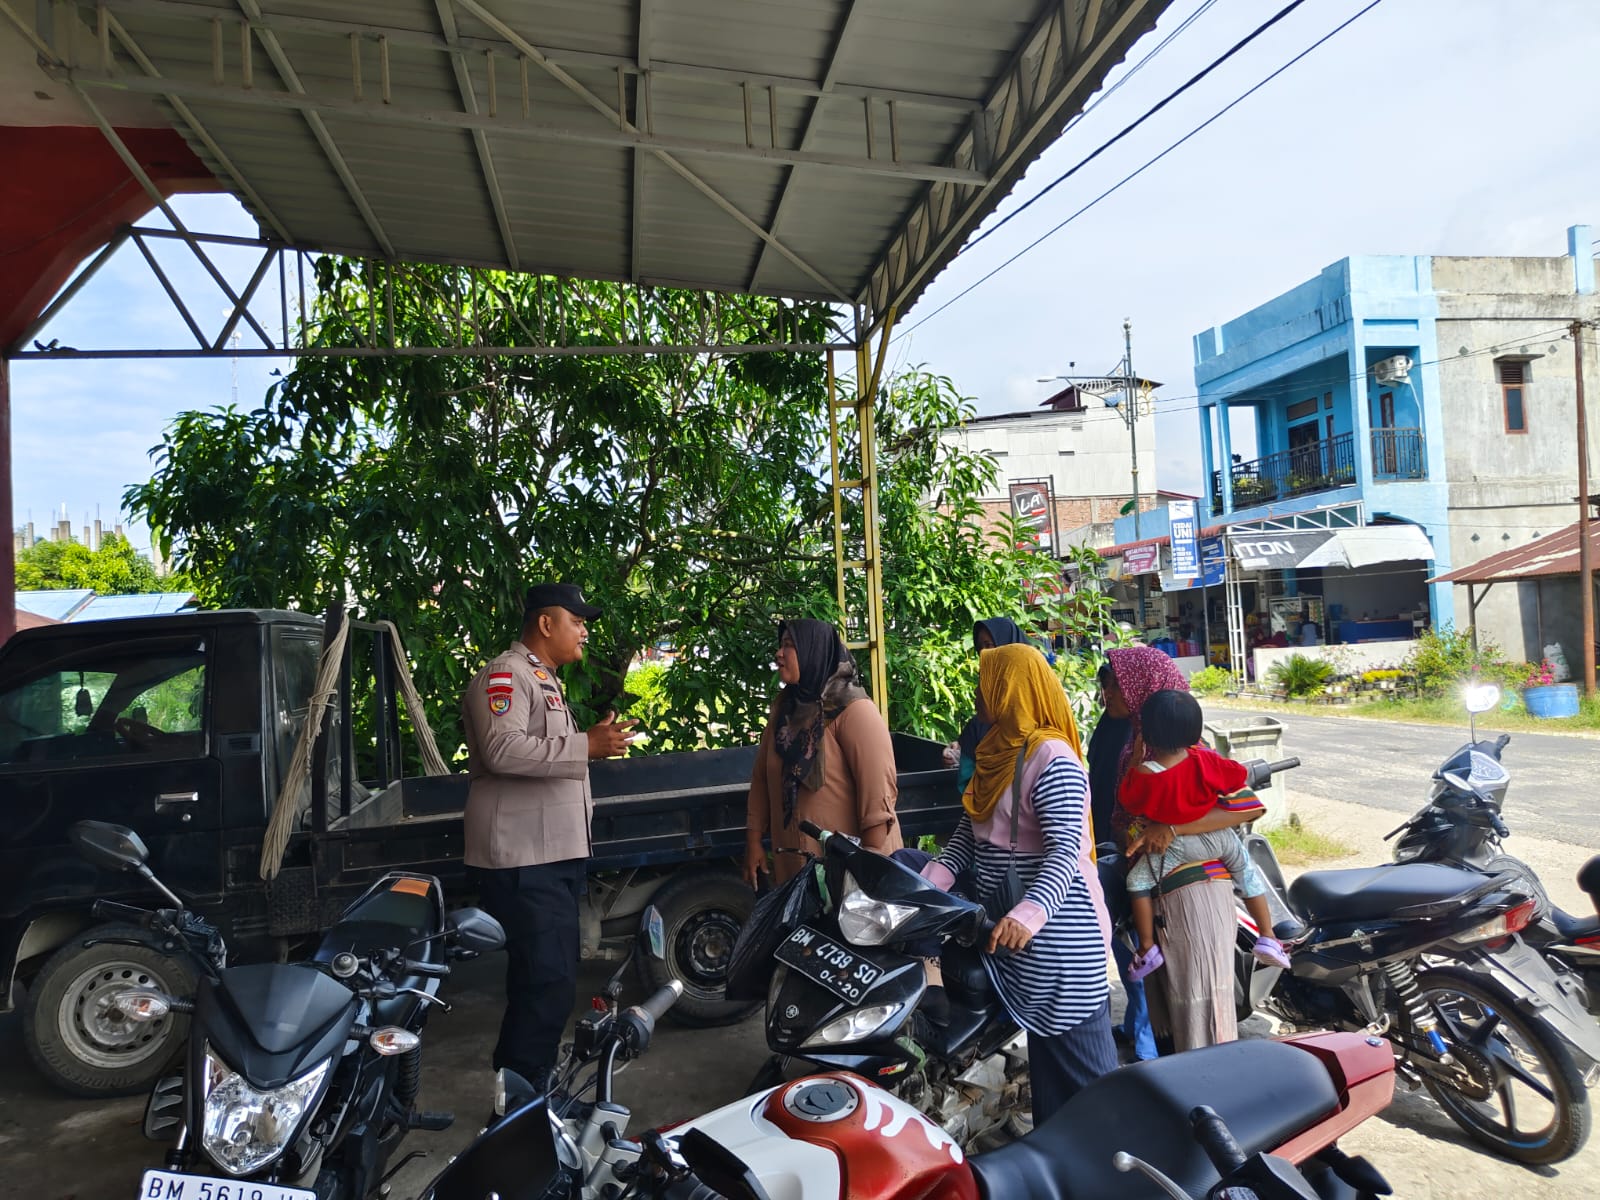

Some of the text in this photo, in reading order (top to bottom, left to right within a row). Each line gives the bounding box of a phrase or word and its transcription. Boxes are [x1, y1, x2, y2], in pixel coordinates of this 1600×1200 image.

[1173, 528, 1193, 538] UNI
[791, 928, 816, 947] BM
[815, 942, 854, 969] 4739
[148, 1177, 185, 1200] BM
